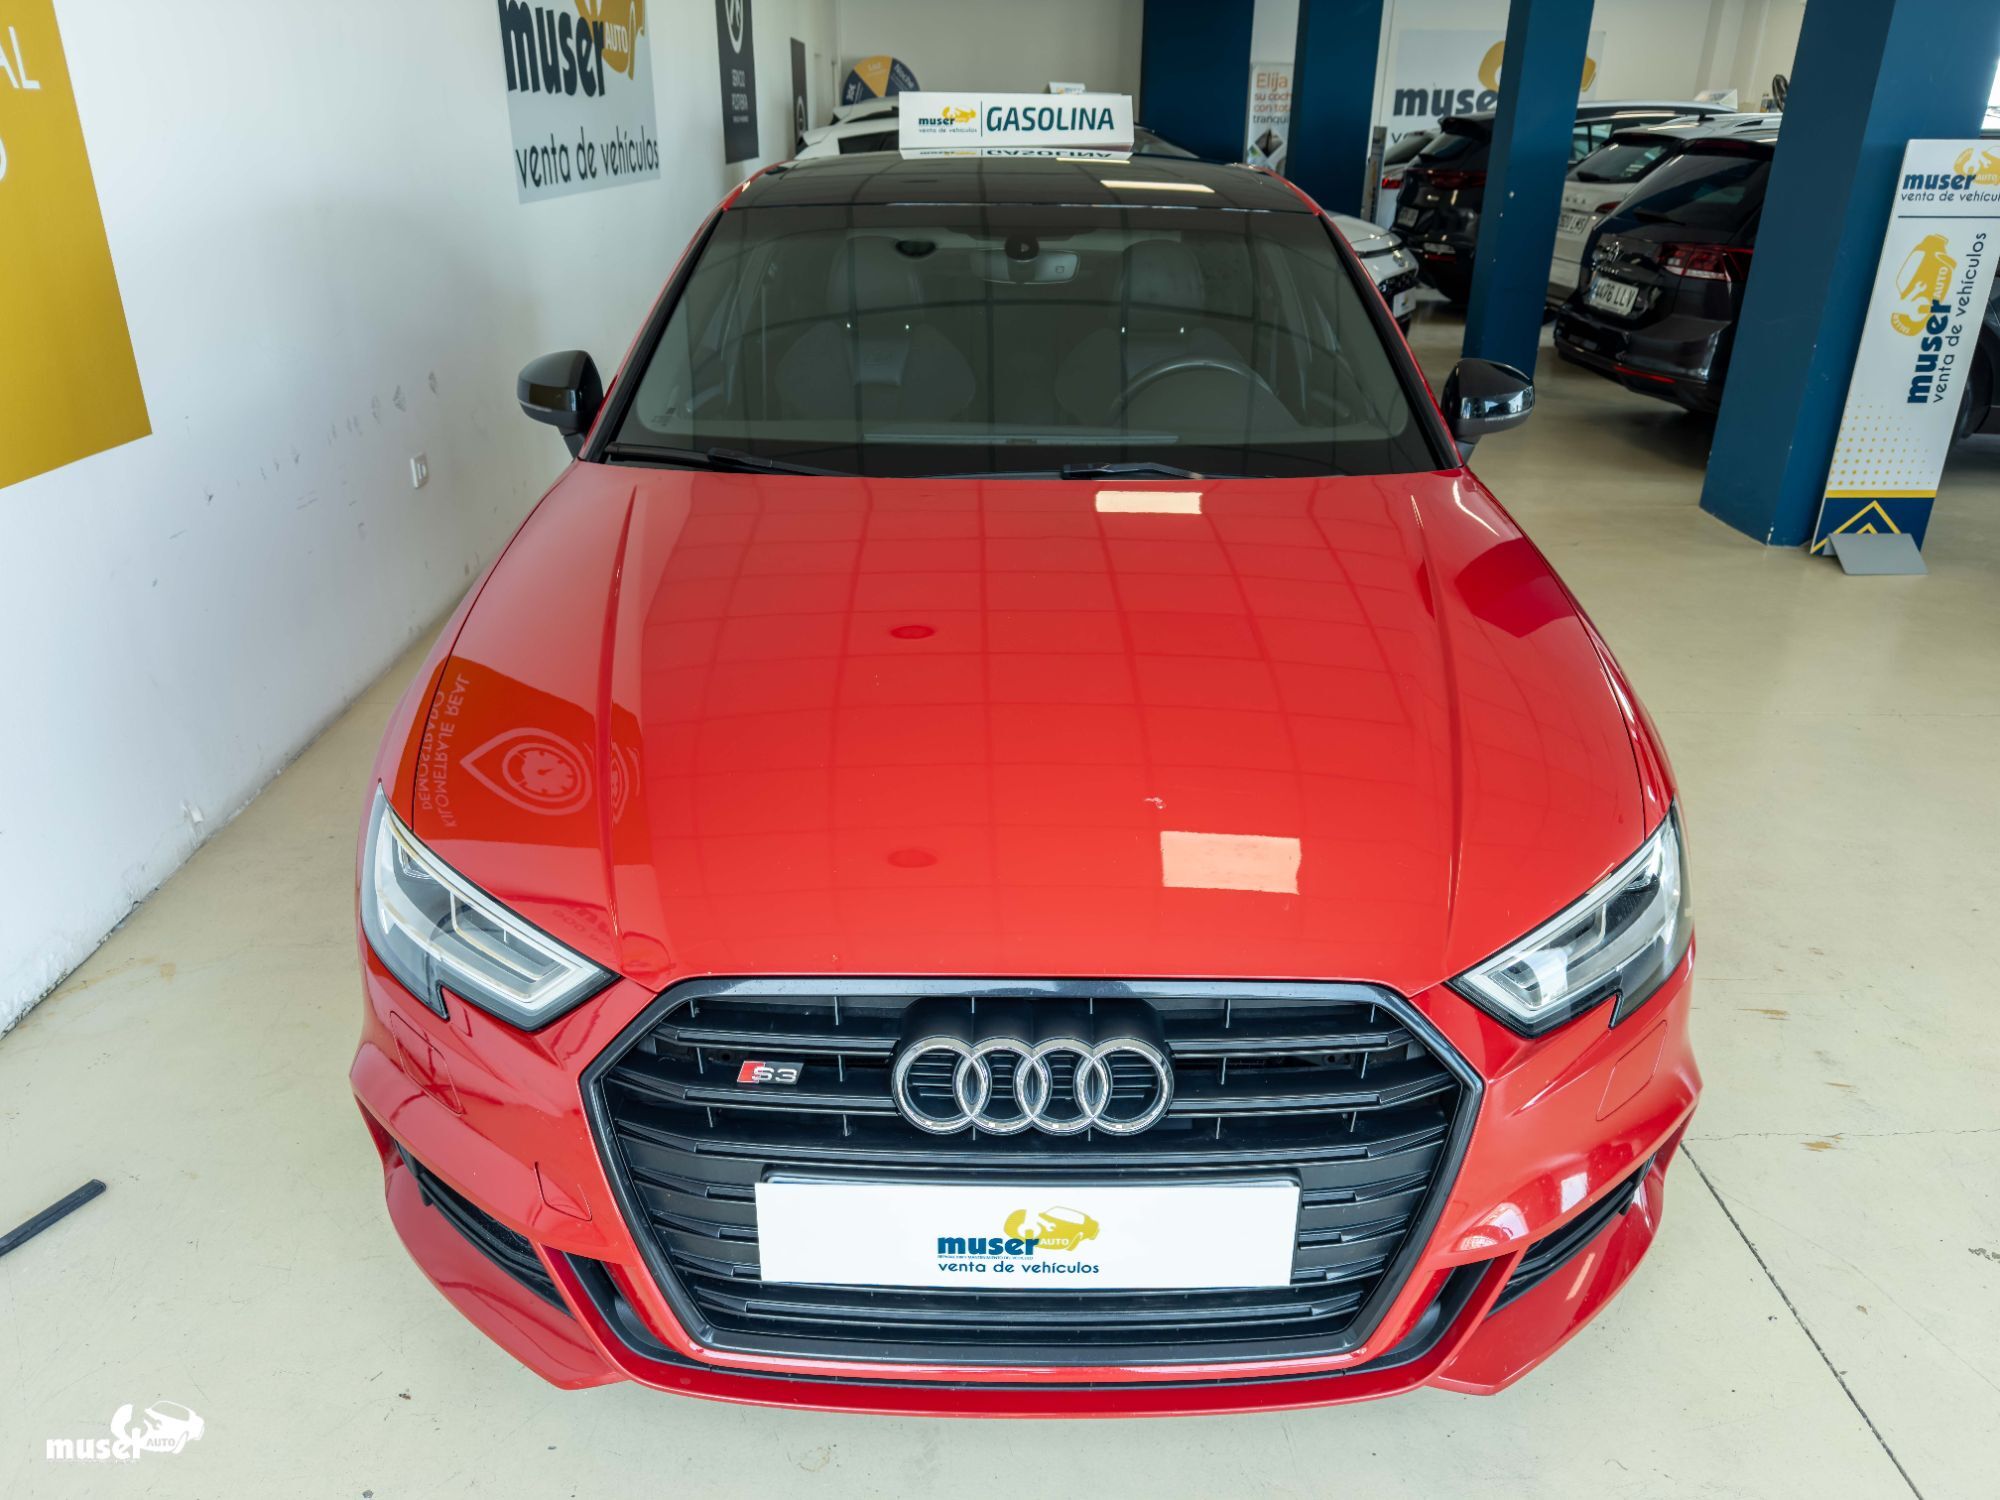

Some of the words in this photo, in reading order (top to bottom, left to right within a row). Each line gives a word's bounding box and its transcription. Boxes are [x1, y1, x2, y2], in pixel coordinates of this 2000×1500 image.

[605, 21, 628, 54] AUTO
[498, 0, 605, 97] muser
[1256, 72, 1288, 92] Elija
[918, 117, 955, 126] muser
[986, 106, 1115, 132] GASOLINA
[515, 132, 571, 188] venta
[576, 126, 597, 181] de
[601, 125, 660, 177] vehículos
[1902, 173, 1976, 191] muser
[1901, 191, 1935, 202] venta
[1939, 191, 1955, 201] de
[1933, 266, 1949, 300] AUTO
[1932, 353, 1955, 403] venta
[1945, 324, 1963, 347] de
[1956, 232, 1987, 317] vehículos
[1907, 299, 1952, 404] muser
[751, 1066, 798, 1083] S3
[937, 1236, 1040, 1256] muser
[1039, 1238, 1069, 1246] AUTO
[938, 1262, 986, 1273] venta
[993, 1261, 1015, 1273] de
[1021, 1261, 1100, 1274] vehículos
